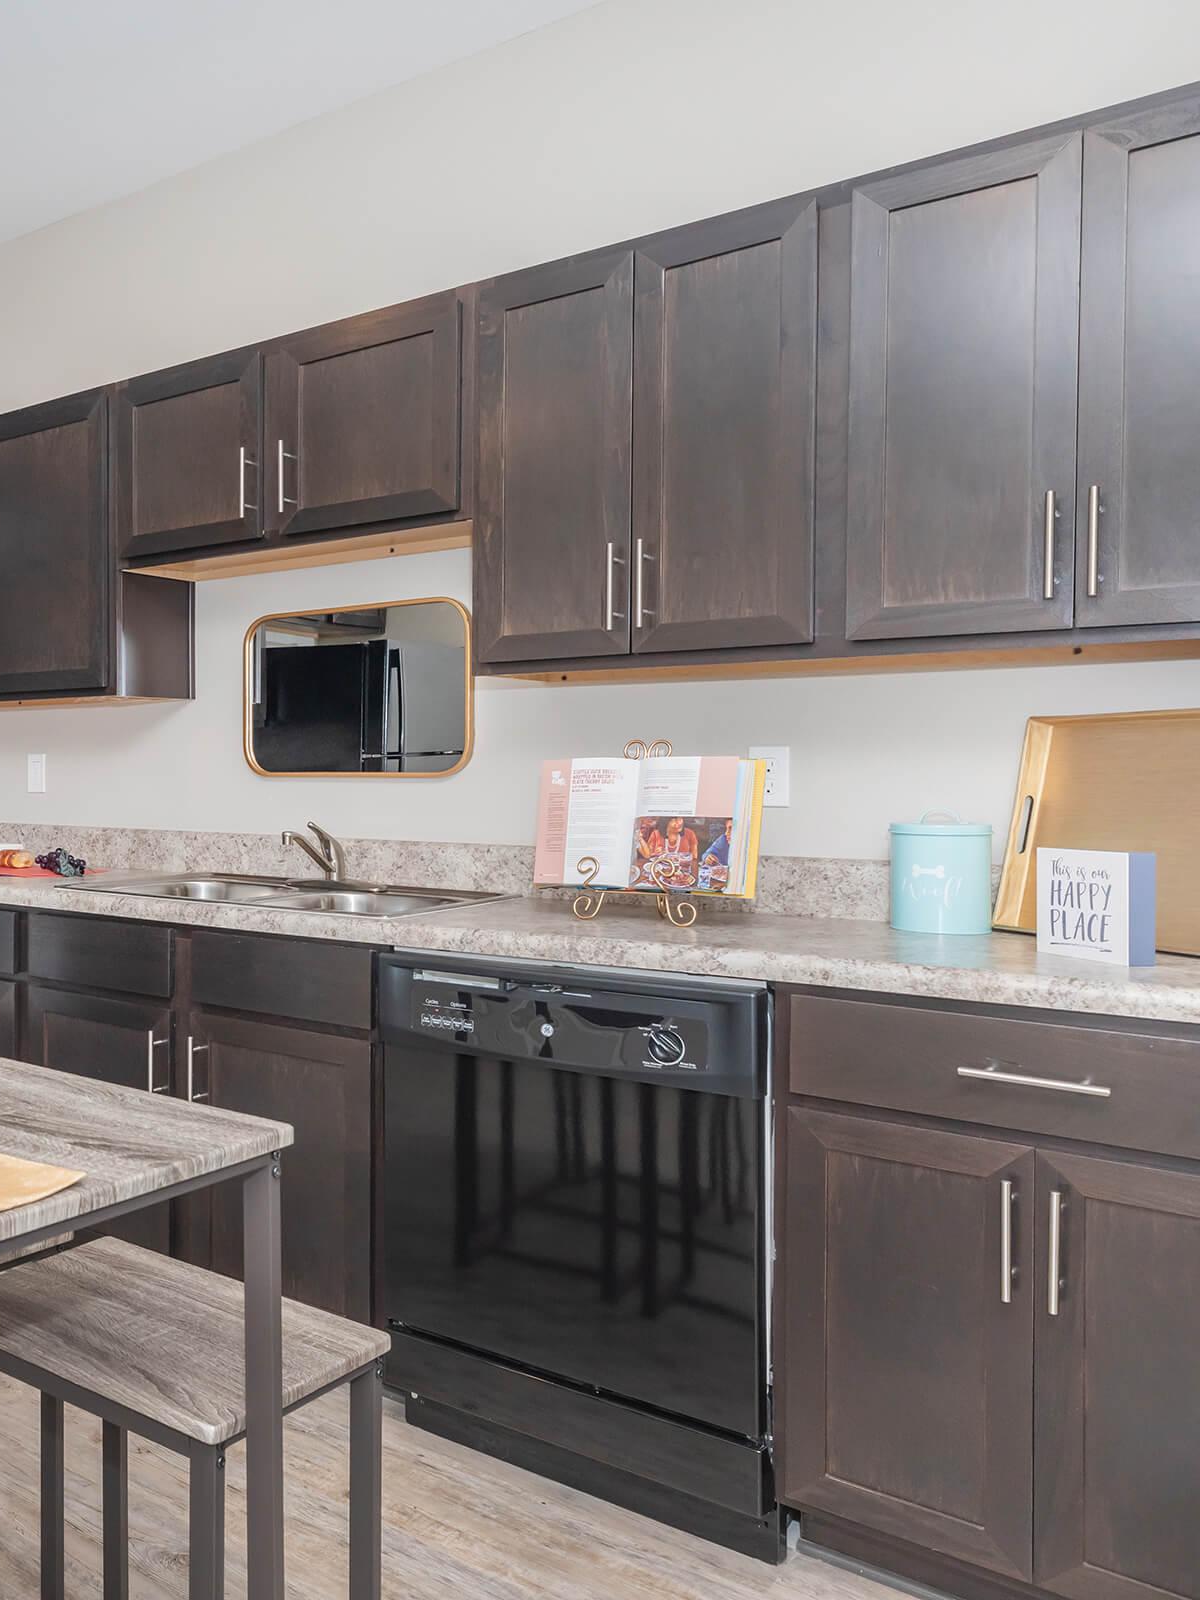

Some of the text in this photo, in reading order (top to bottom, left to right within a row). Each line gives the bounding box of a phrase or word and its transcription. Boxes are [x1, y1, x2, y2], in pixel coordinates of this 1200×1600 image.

[1050, 856, 1110, 881] This is our
[1050, 879, 1112, 911] HAPPY
[1050, 908, 1112, 942] PLACE
